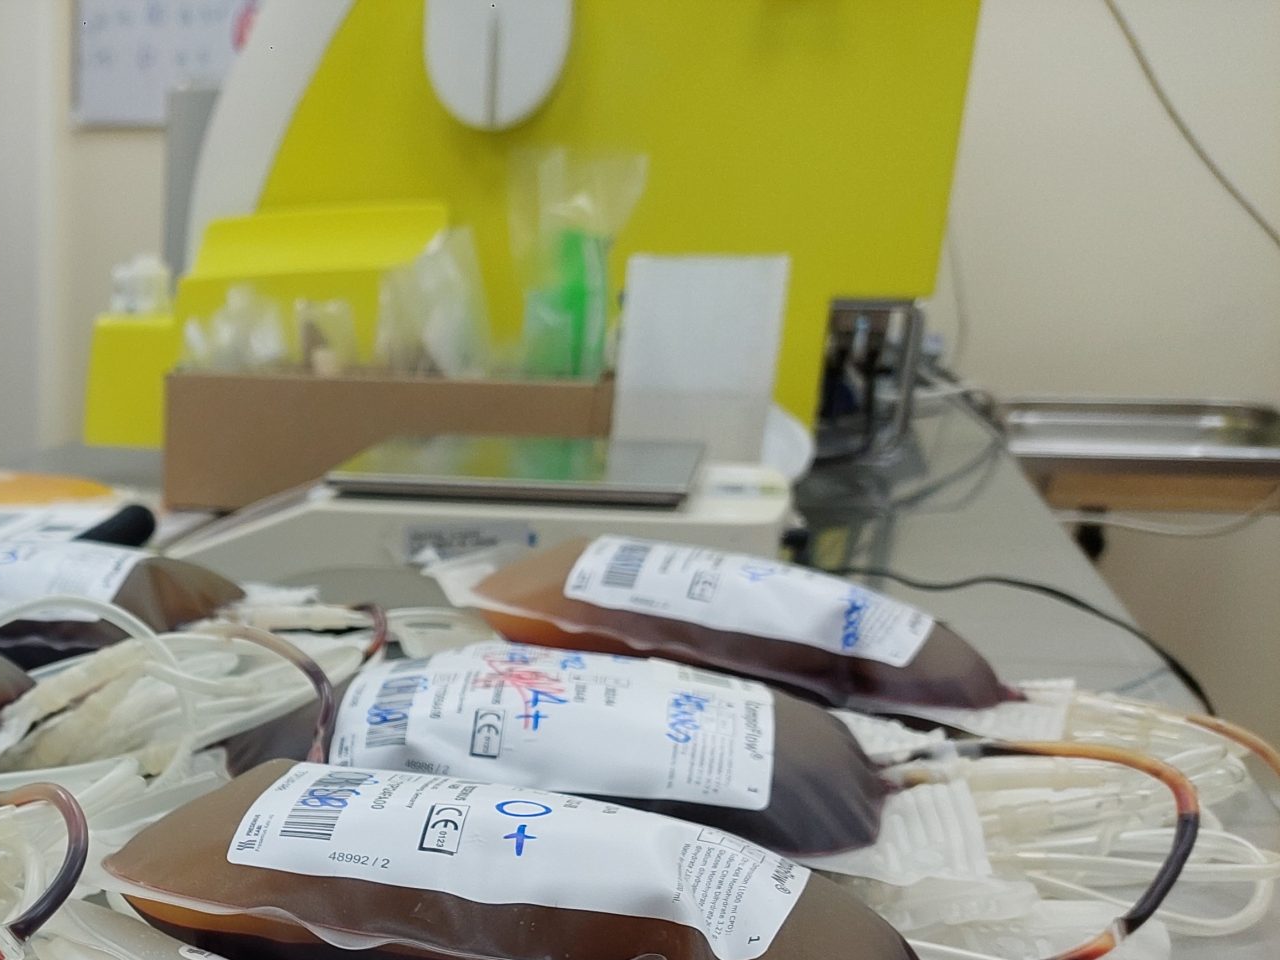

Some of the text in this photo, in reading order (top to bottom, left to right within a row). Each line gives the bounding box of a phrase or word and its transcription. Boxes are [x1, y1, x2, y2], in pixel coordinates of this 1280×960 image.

[515, 687, 568, 731] A+
[429, 806, 464, 831] CE
[495, 799, 553, 857] O+
[435, 830, 448, 848] 0123
[327, 850, 370, 867] 48992
[380, 858, 391, 869] 2
[747, 935, 761, 945] 1
